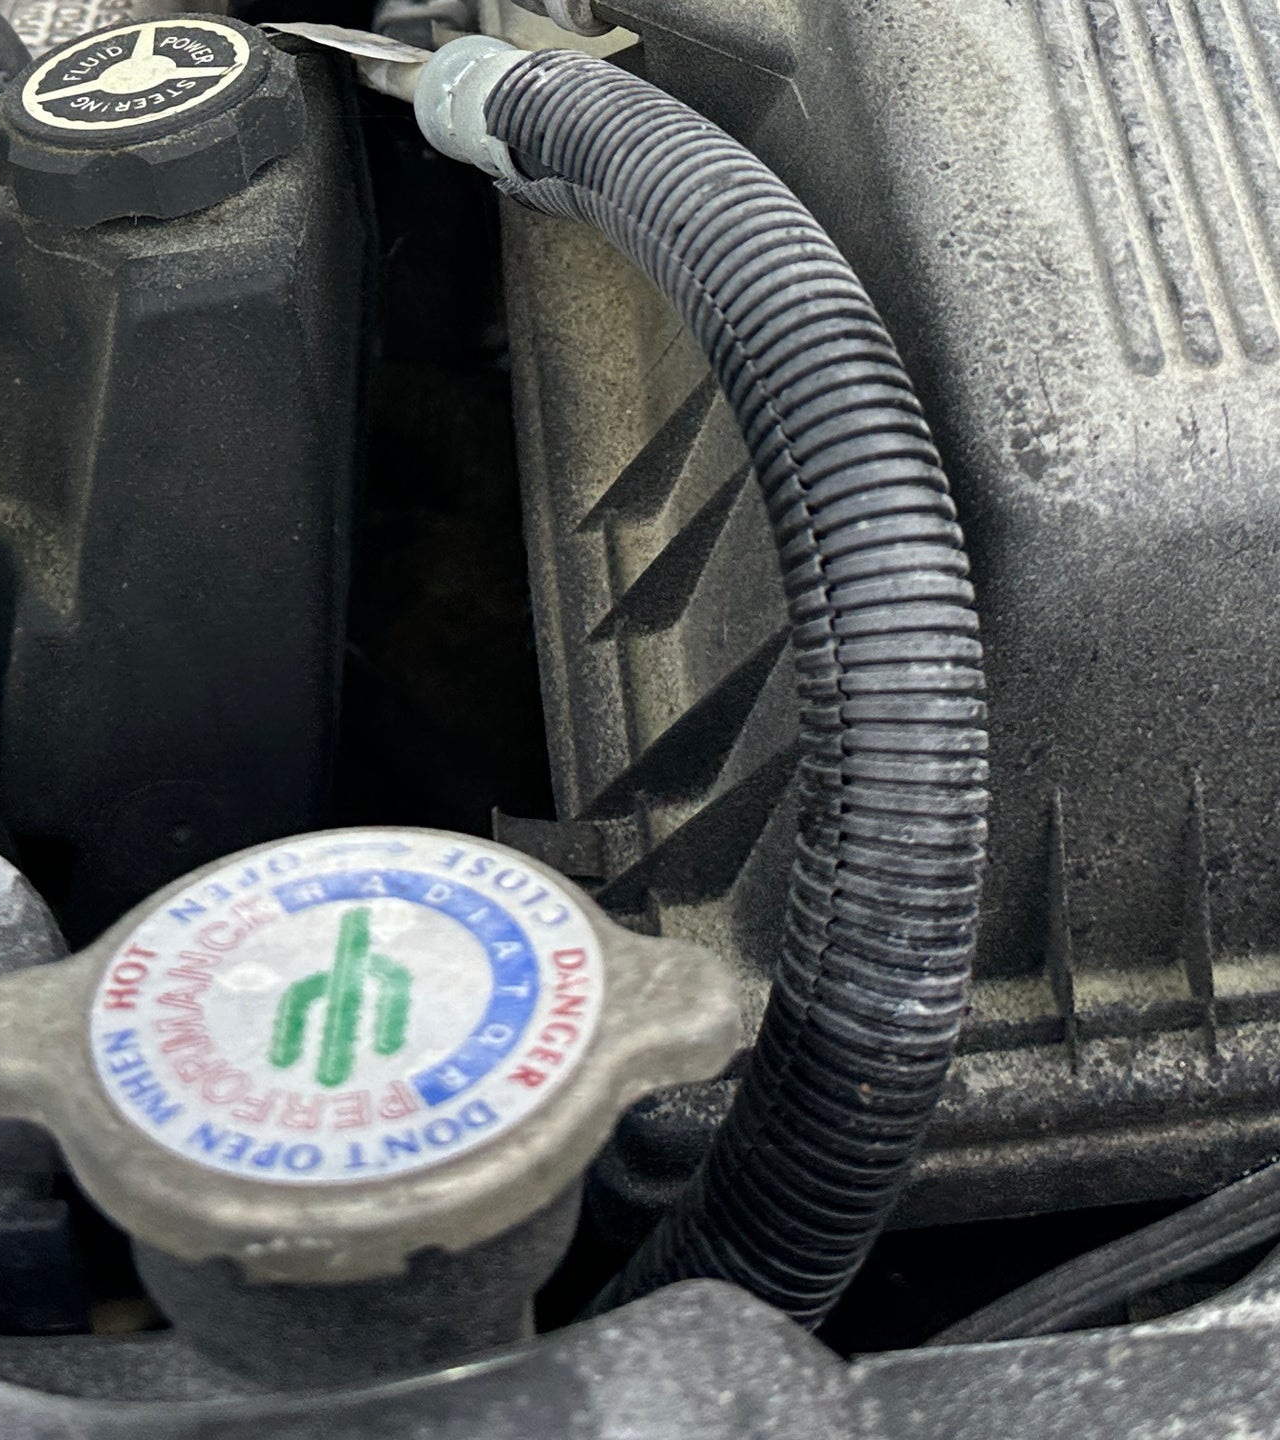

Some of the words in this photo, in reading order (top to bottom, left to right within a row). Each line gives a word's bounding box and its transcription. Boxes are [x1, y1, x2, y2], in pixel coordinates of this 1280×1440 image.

[62, 45, 124, 83] FLUID
[160, 36, 215, 66] POWER
[70, 79, 197, 114] STEERING
[168, 851, 301, 923] OPEN
[435, 847, 570, 927] CLOSE
[103, 942, 158, 1010] HOT
[154, 894, 420, 1130] PERFORMANCE
[293, 876, 530, 1093] RADIATOR
[507, 947, 590, 1089] DANGER
[102, 1027, 185, 1127] WHEN
[187, 1121, 325, 1172] OPEN
[344, 1099, 499, 1169] DON'T
